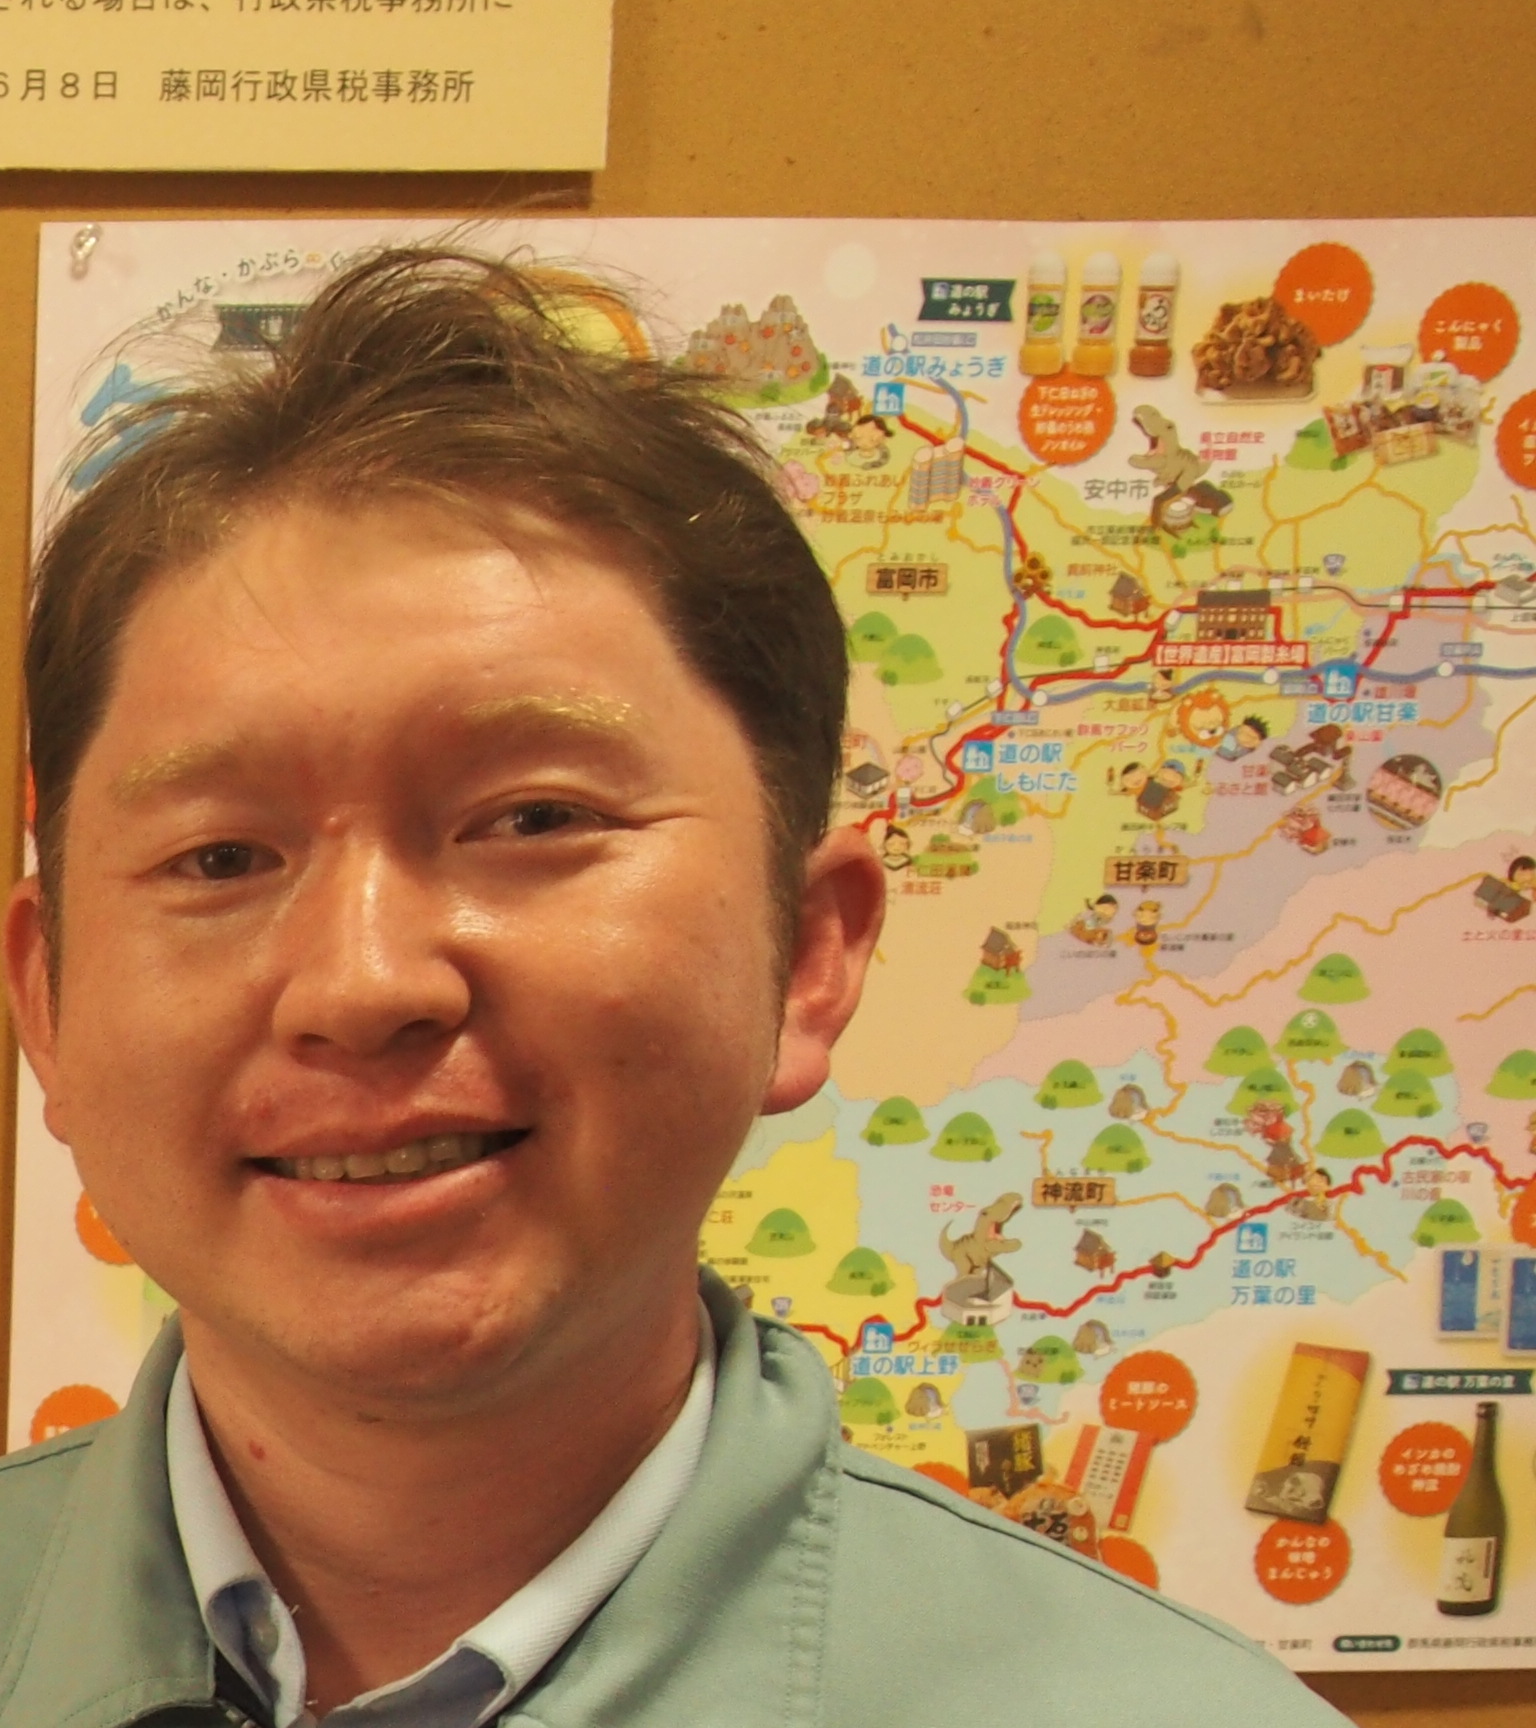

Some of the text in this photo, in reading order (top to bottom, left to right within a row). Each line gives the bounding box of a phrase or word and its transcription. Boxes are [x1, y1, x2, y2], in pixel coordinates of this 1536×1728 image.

[158, 67, 477, 103] 藤岡行政県税事務所
[1293, 288, 1352, 304] まいたけ
[861, 354, 1007, 378] 道の駅みょうぎ
[1083, 479, 1151, 501] 安中市
[875, 567, 939, 590] 富岡市
[1306, 701, 1420, 724] 道の駅甘楽
[997, 742, 1064, 764] 道の駅
[995, 771, 1078, 793] しもにた
[1113, 860, 1179, 883] 甘楽町
[929, 1185, 955, 1198] 恐竜
[1041, 1182, 1108, 1203] 神流町
[929, 1202, 976, 1214] センター
[1231, 1258, 1297, 1279] 道の駅
[1230, 1285, 1317, 1306] 万葉の里
[851, 1354, 959, 1376] 道の駅上野
[1108, 1397, 1188, 1411] ミートソース
